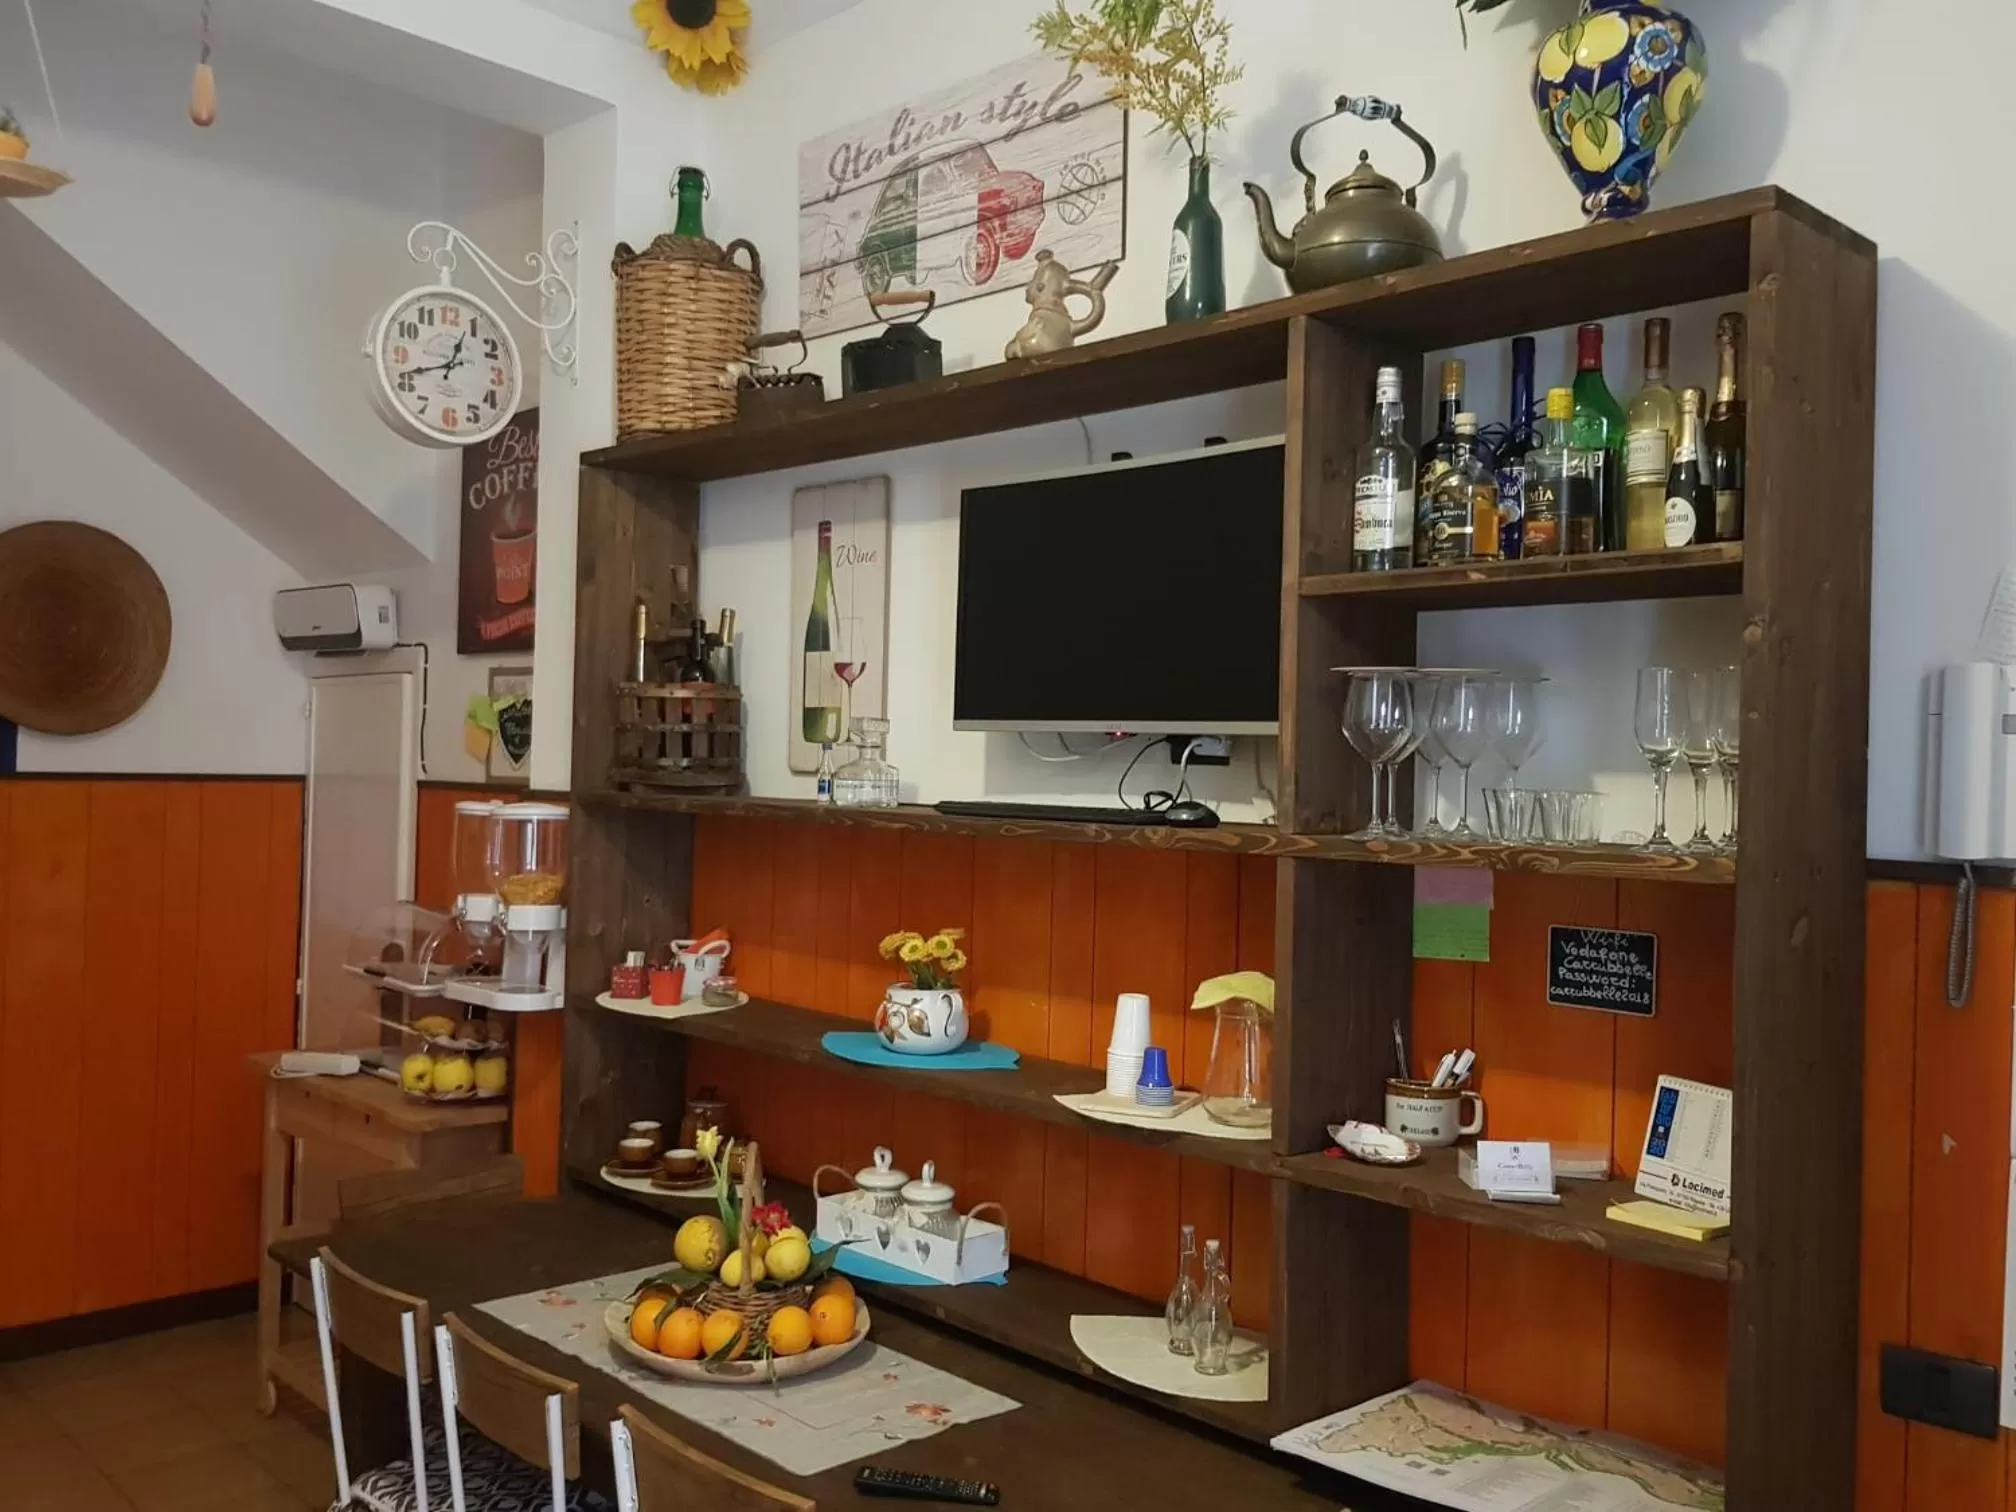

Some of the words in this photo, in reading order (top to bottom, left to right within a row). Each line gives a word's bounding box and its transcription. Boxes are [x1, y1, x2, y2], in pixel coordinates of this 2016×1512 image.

[823, 106, 967, 203] Italian
[979, 73, 1084, 142] style
[417, 306, 435, 327] 11
[440, 305, 460, 327] 12
[469, 316, 478, 338] 1
[398, 320, 419, 341] 10
[393, 345, 409, 364] 9
[483, 338, 498, 361] 2
[397, 371, 416, 393] 8
[490, 365, 504, 388] 3
[416, 395, 429, 415] 7
[483, 389, 497, 411] 4
[441, 406, 458, 429] 6
[466, 403, 480, 425] 5
[836, 544, 877, 568] Wine
[1560, 939, 1639, 964] Vodafone
[1682, 1177, 1725, 1199] Locimed
